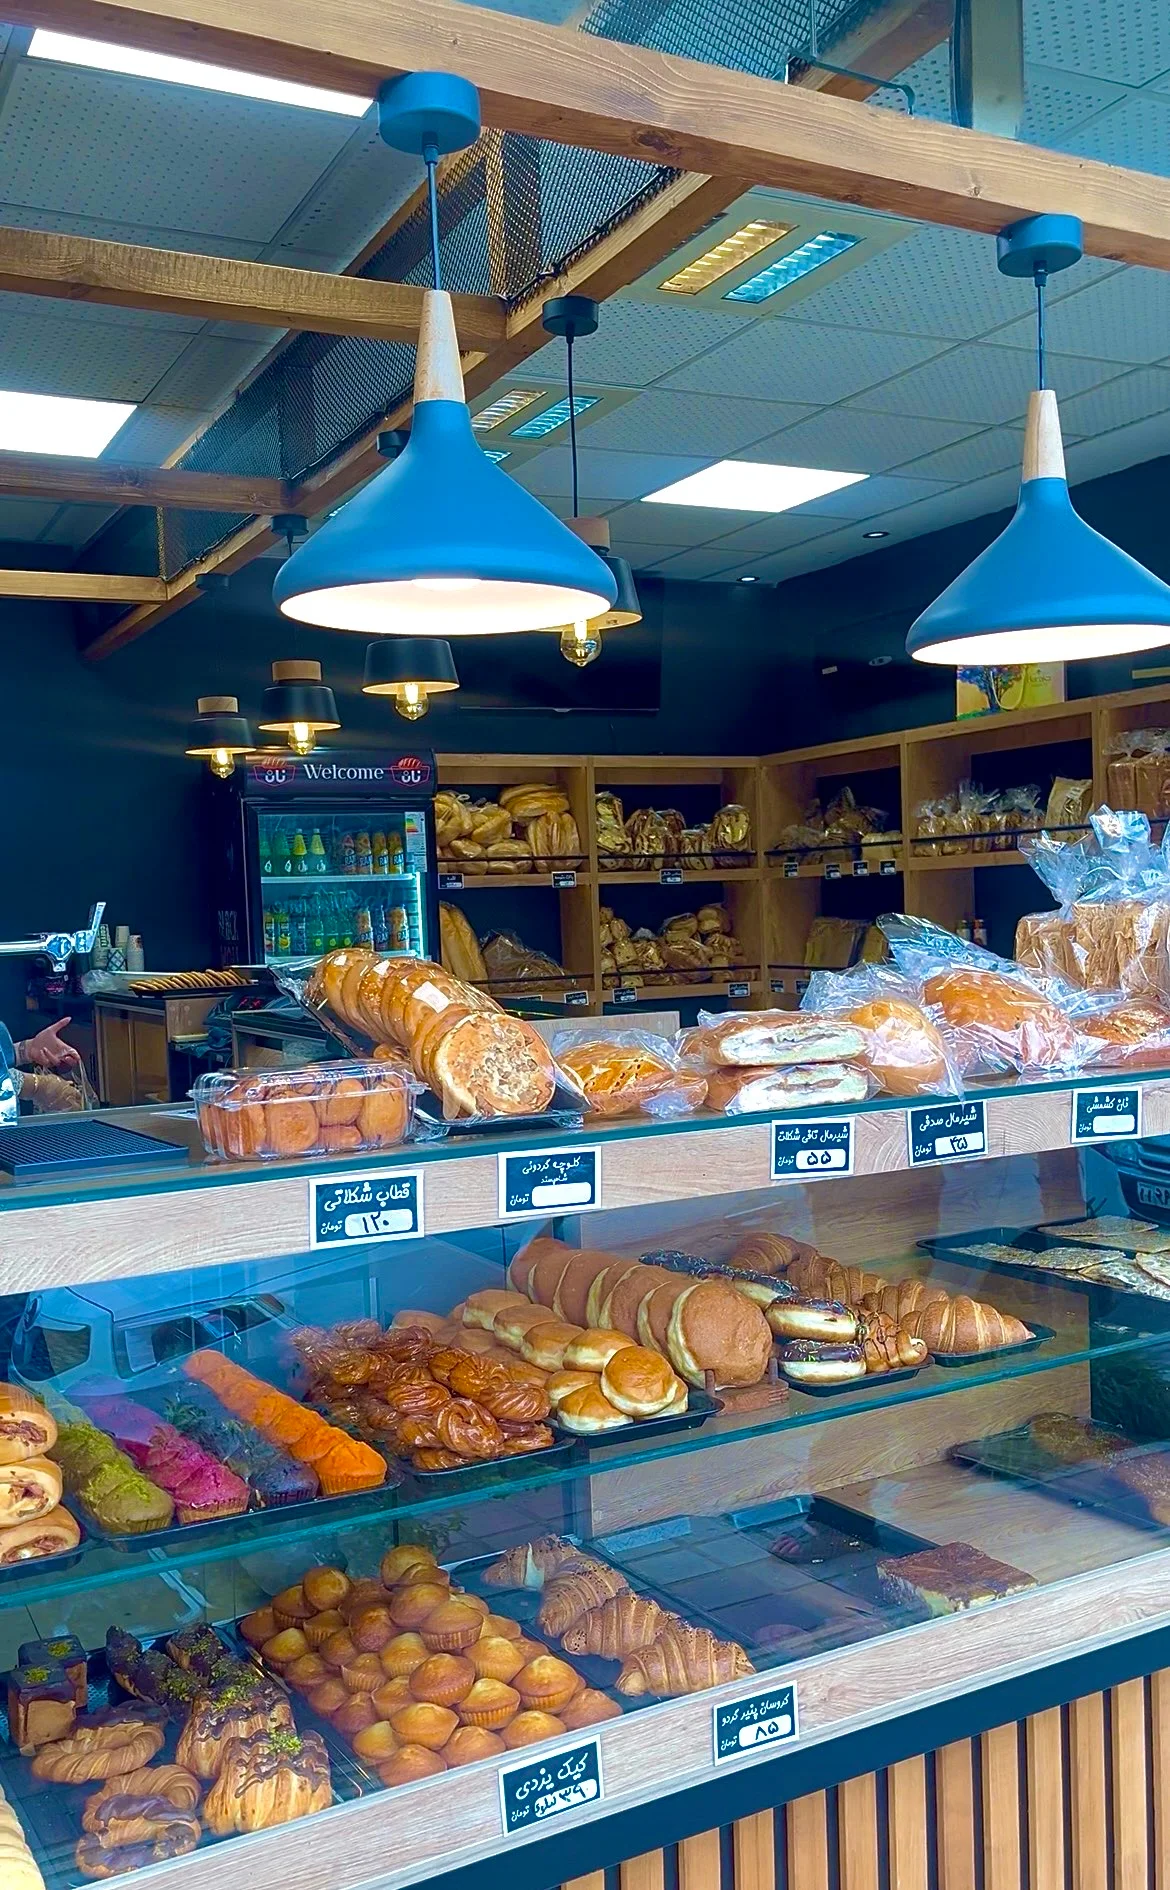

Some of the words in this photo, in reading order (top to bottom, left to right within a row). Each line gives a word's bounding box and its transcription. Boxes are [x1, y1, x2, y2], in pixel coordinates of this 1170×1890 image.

[303, 764, 384, 780] Welcome
[1086, 1095, 1116, 1113] کشمشی
[1116, 1096, 1129, 1112] نان
[919, 1114, 944, 1132] صدفی
[945, 1105, 978, 1128] شیرمال
[801, 1129, 819, 1143] تافی
[819, 1125, 849, 1143] شیرمال
[914, 1142, 933, 1157] تومان
[950, 1136, 968, 1153] ۴۵
[552, 1156, 581, 1174] کلوچه
[777, 1155, 795, 1167] تومان
[807, 1151, 832, 1165] ۵۵
[323, 1181, 373, 1212] شکلاتی
[375, 1182, 411, 1208] قطاب
[509, 1193, 530, 1206] تومان
[320, 1220, 343, 1235] تومان
[362, 1211, 390, 1233] ۱۲۰
[740, 1703, 759, 1721] پنیر
[760, 1692, 790, 1715] کروسان
[755, 1721, 779, 1740] ۸۵
[720, 1735, 738, 1751] تومان
[557, 1752, 589, 1781] کیک
[515, 1767, 555, 1800] یزدی
[511, 1805, 530, 1822] تومان
